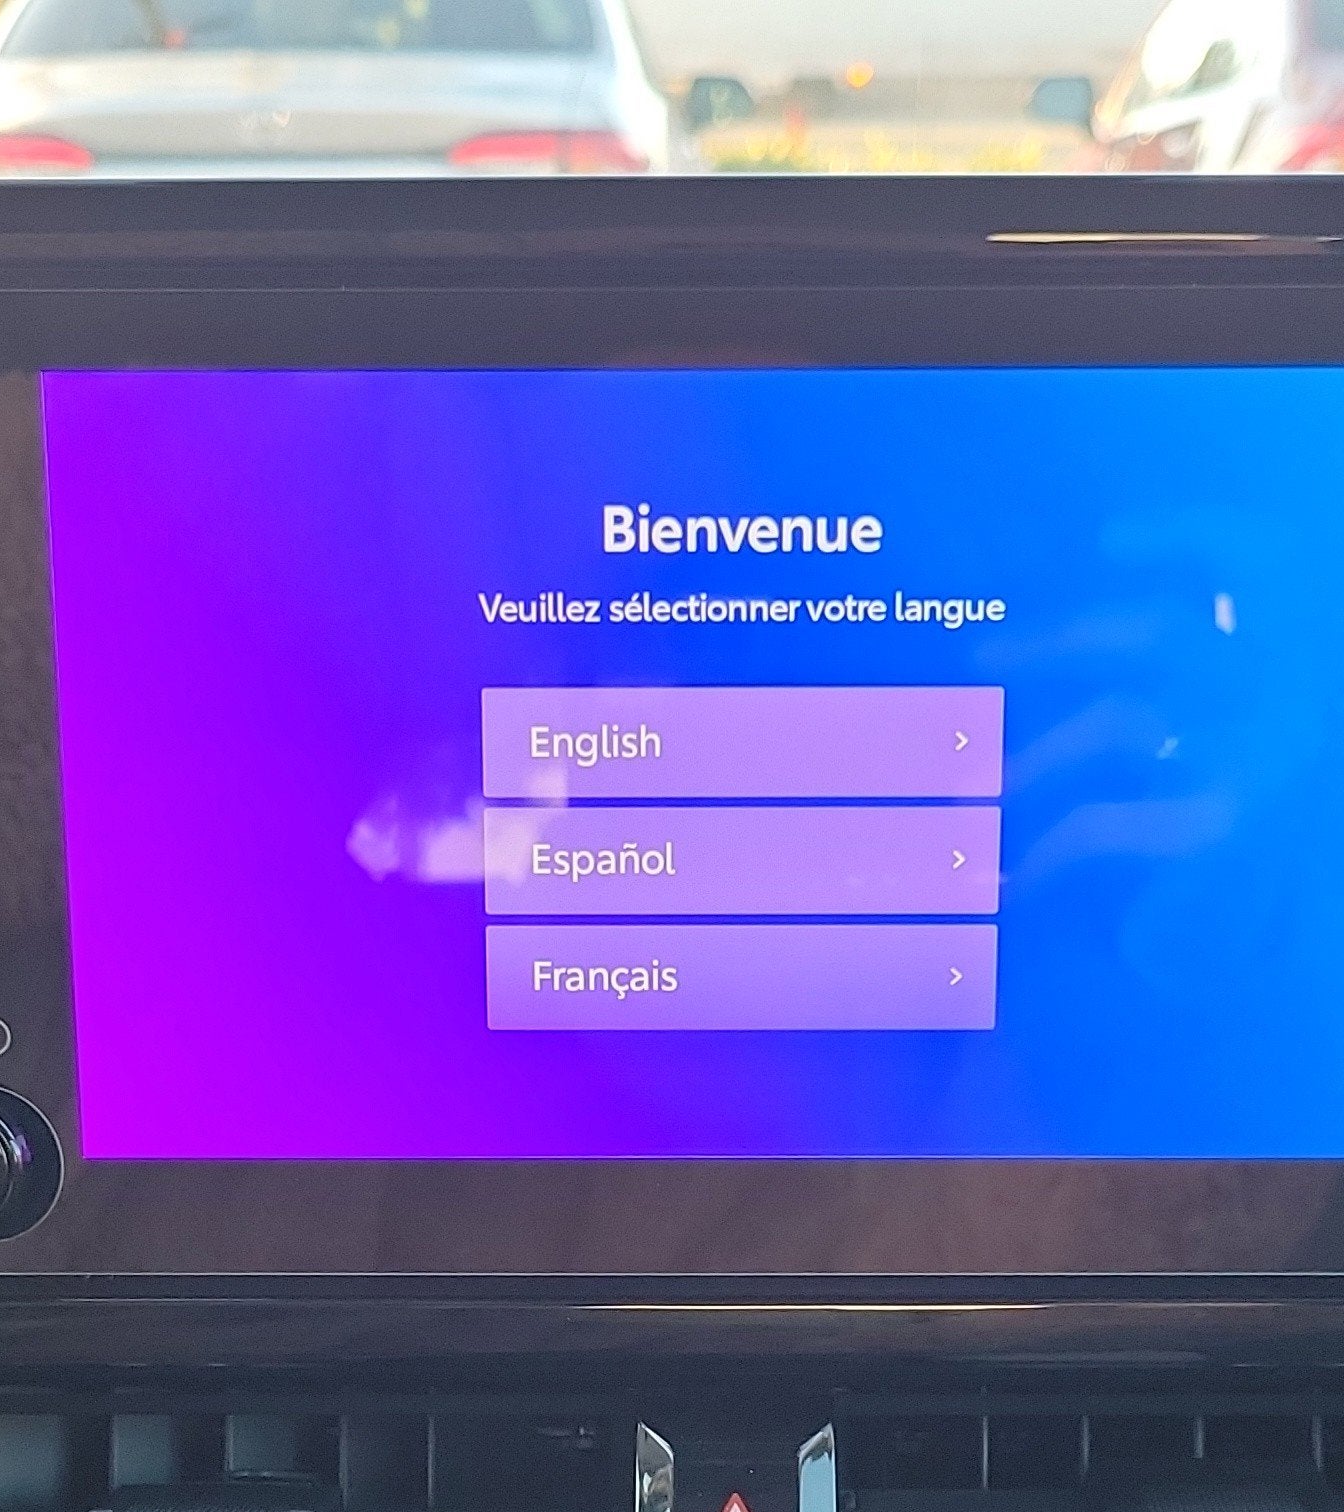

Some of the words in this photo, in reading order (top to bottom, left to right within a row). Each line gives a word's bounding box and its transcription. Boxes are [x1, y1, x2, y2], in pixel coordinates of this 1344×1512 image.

[602, 503, 883, 554] Bienvenue
[478, 591, 601, 623] Veuillez
[609, 591, 802, 623] sélectionner
[805, 594, 887, 622] votre
[895, 590, 1006, 629] langue
[529, 725, 662, 767] English
[531, 842, 676, 883] Español
[532, 960, 678, 1000] Français
